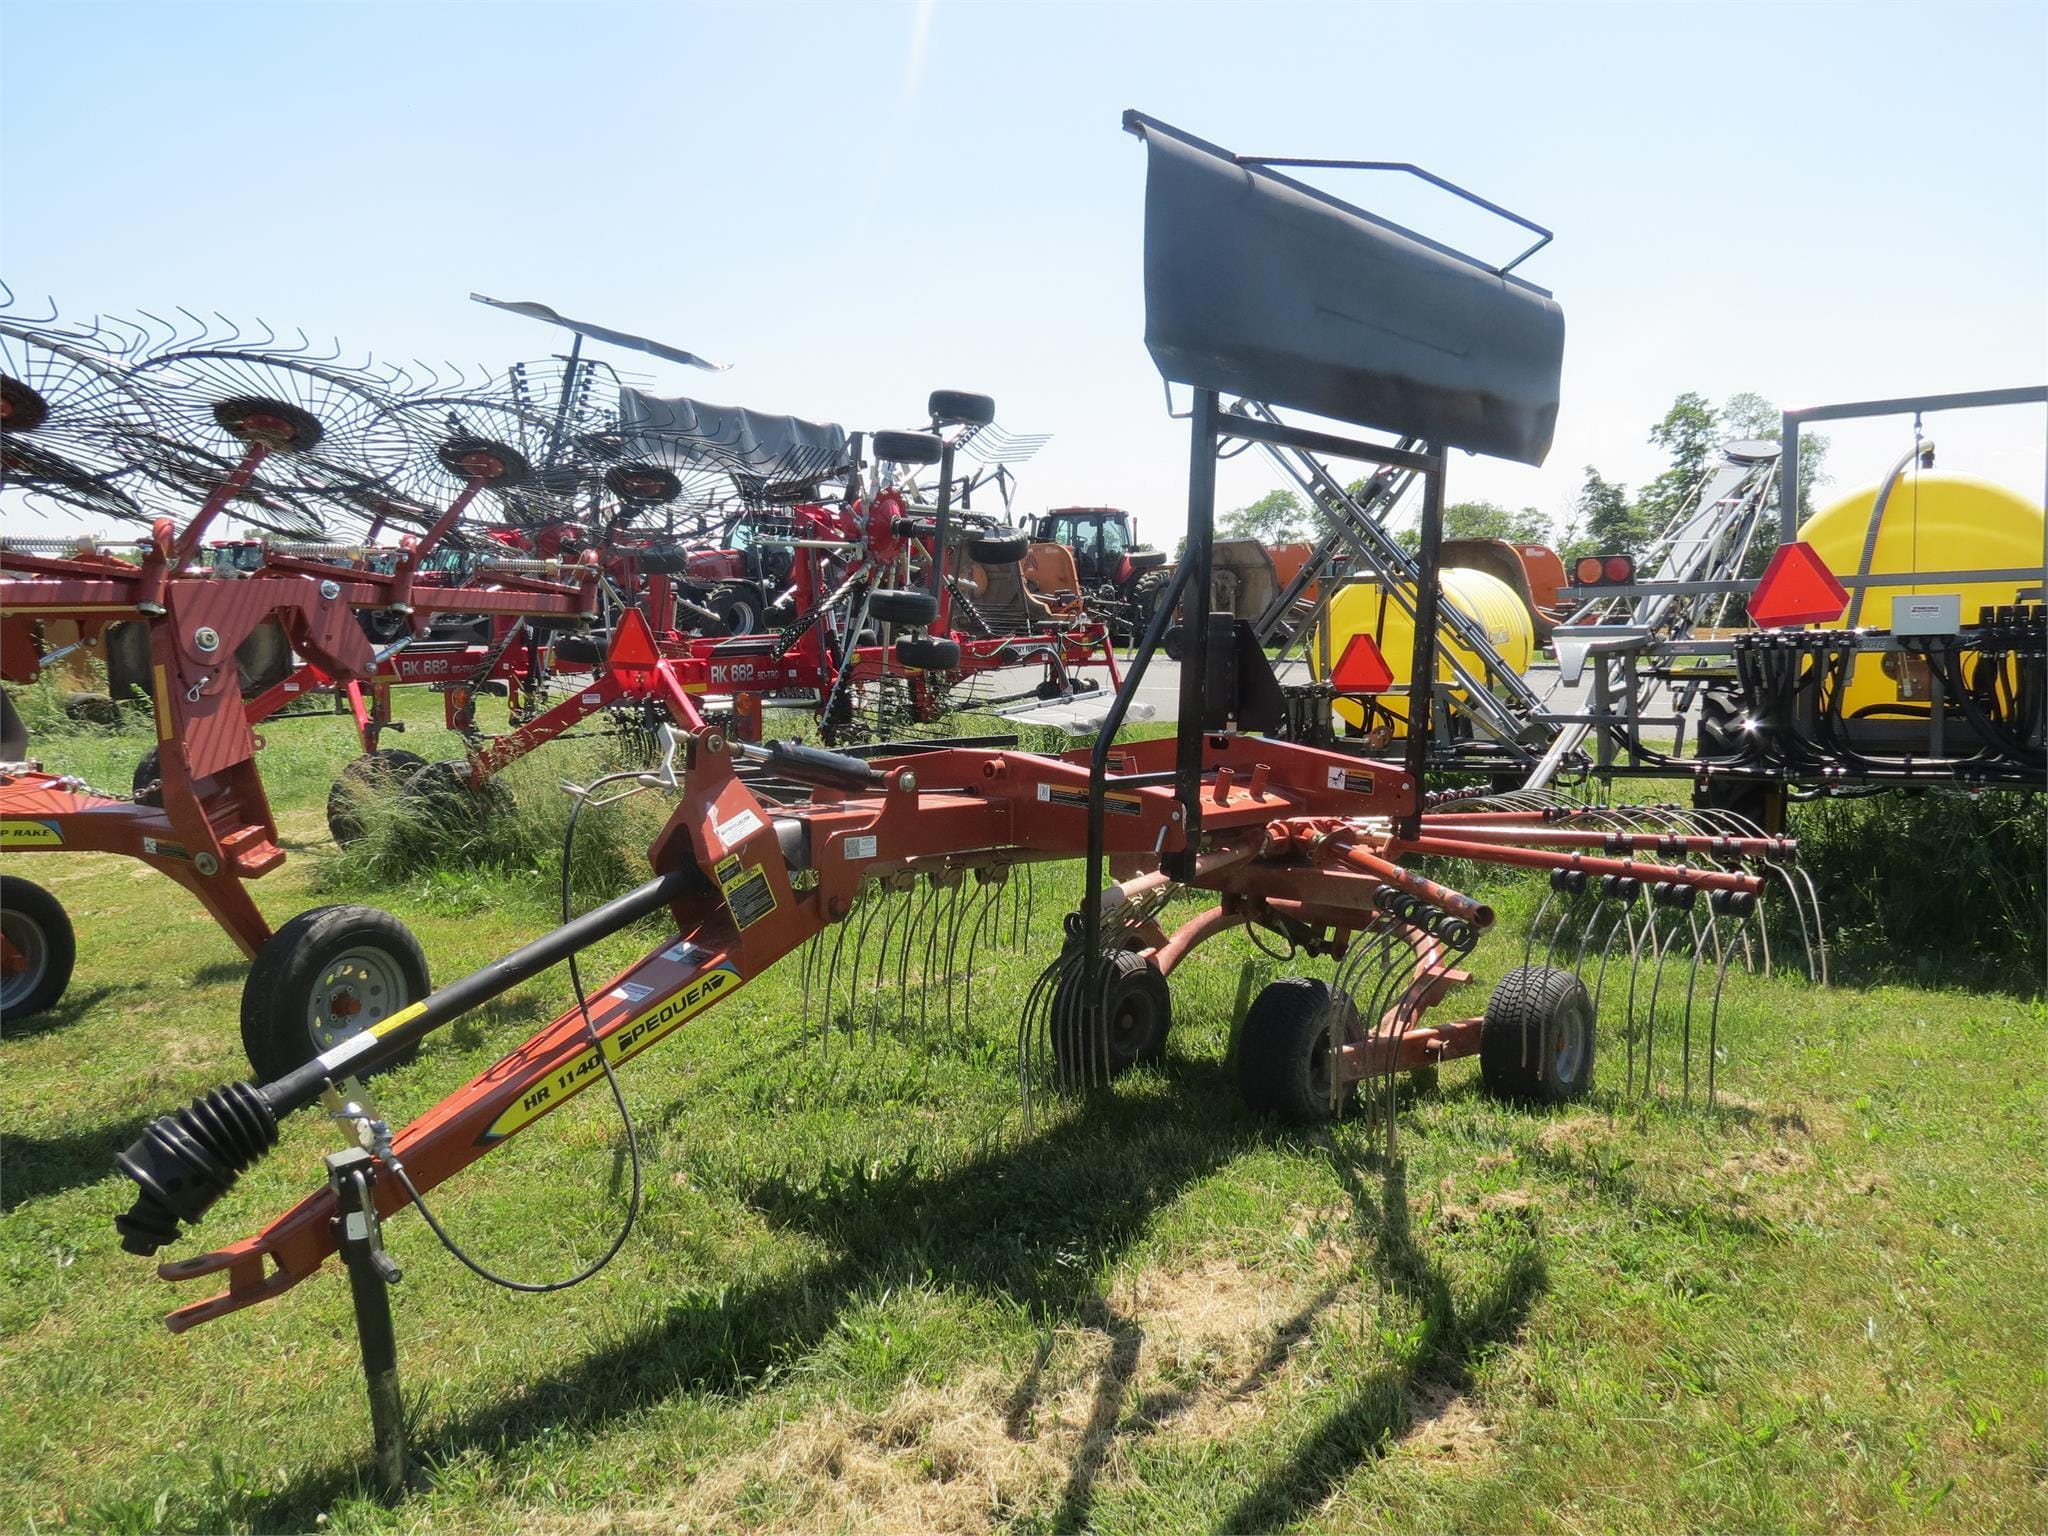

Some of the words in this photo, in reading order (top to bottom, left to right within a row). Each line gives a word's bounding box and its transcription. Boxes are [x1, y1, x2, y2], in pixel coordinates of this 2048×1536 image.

[402, 661, 420, 676] RK
[423, 659, 448, 675] 662
[710, 664, 729, 684] RK
[731, 663, 754, 682] 662
[14, 829, 50, 837] RAKE
[733, 867, 760, 886] CAUTION
[523, 1086, 551, 1111] HR
[558, 1053, 601, 1089] 1140
[631, 982, 716, 1043] PEQUEA
